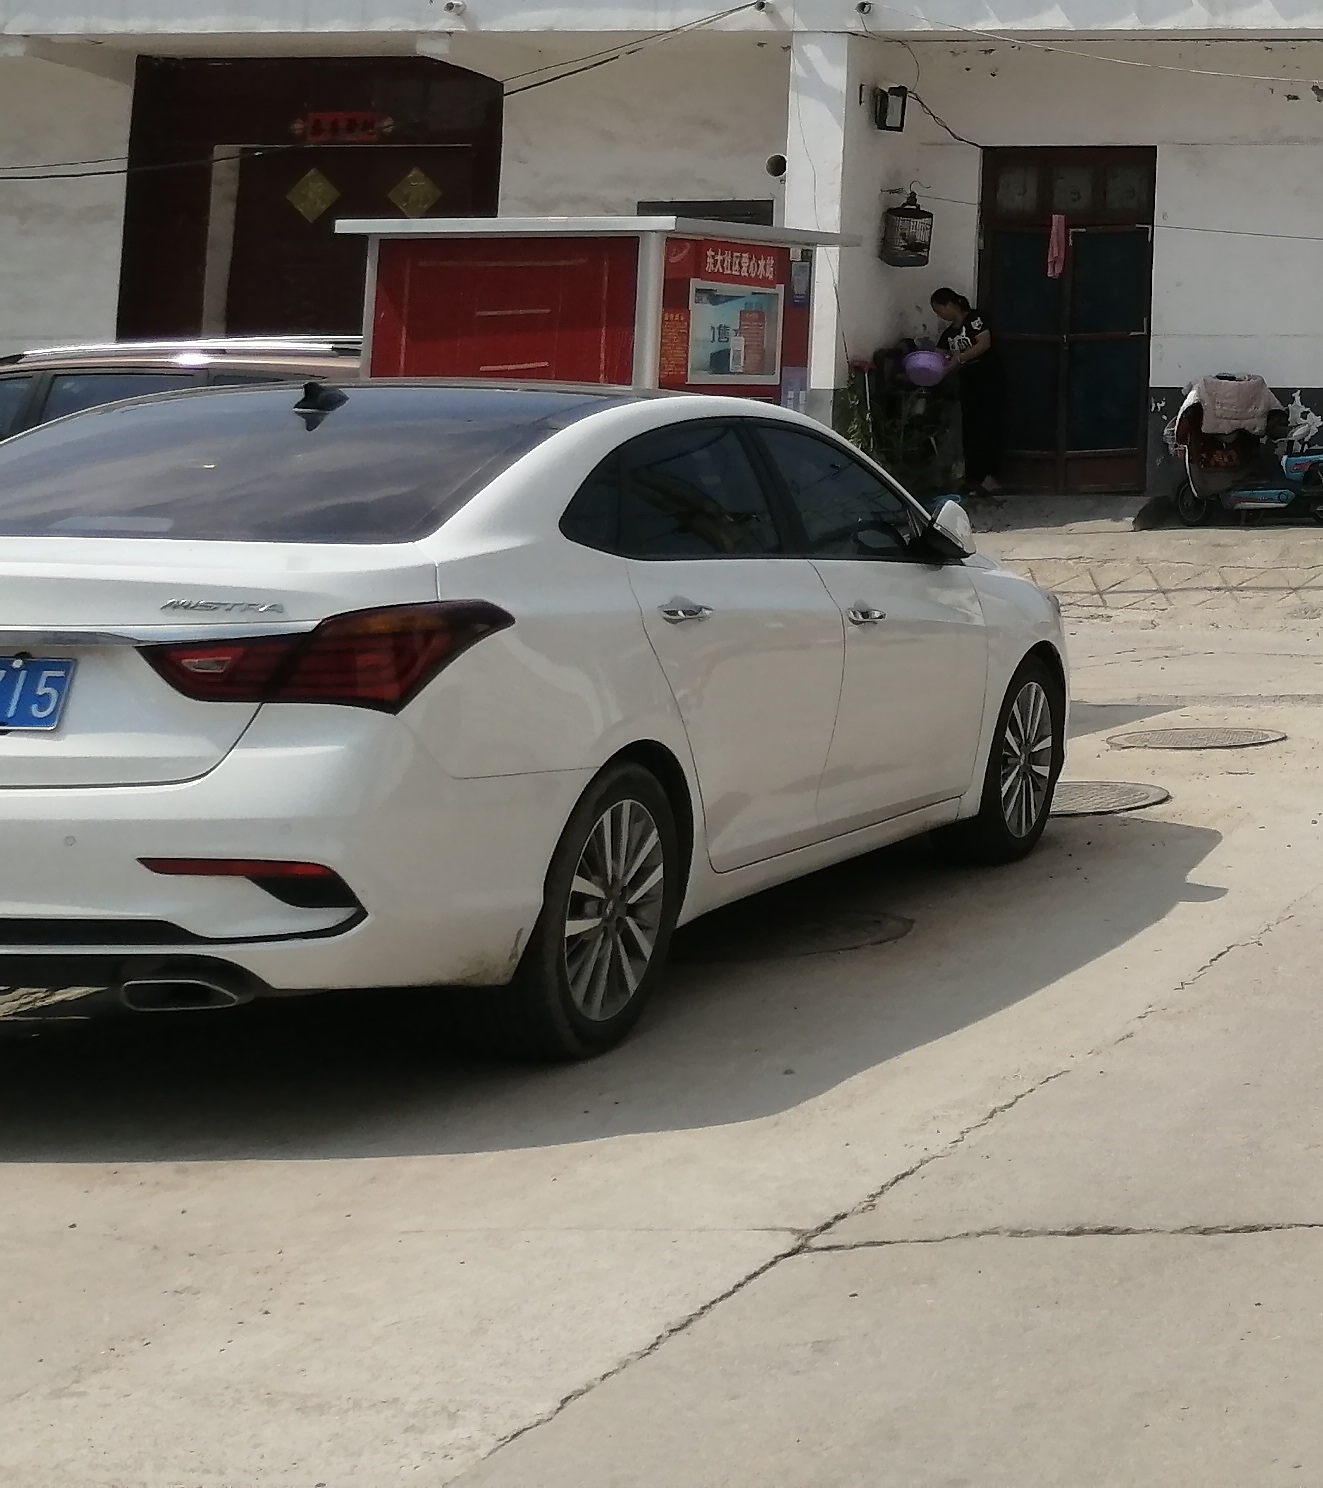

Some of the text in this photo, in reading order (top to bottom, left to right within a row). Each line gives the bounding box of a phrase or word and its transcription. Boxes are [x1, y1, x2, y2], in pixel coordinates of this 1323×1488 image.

[705, 247, 775, 281] 东大社区爱心水站
[160, 598, 284, 613] MISTRA
